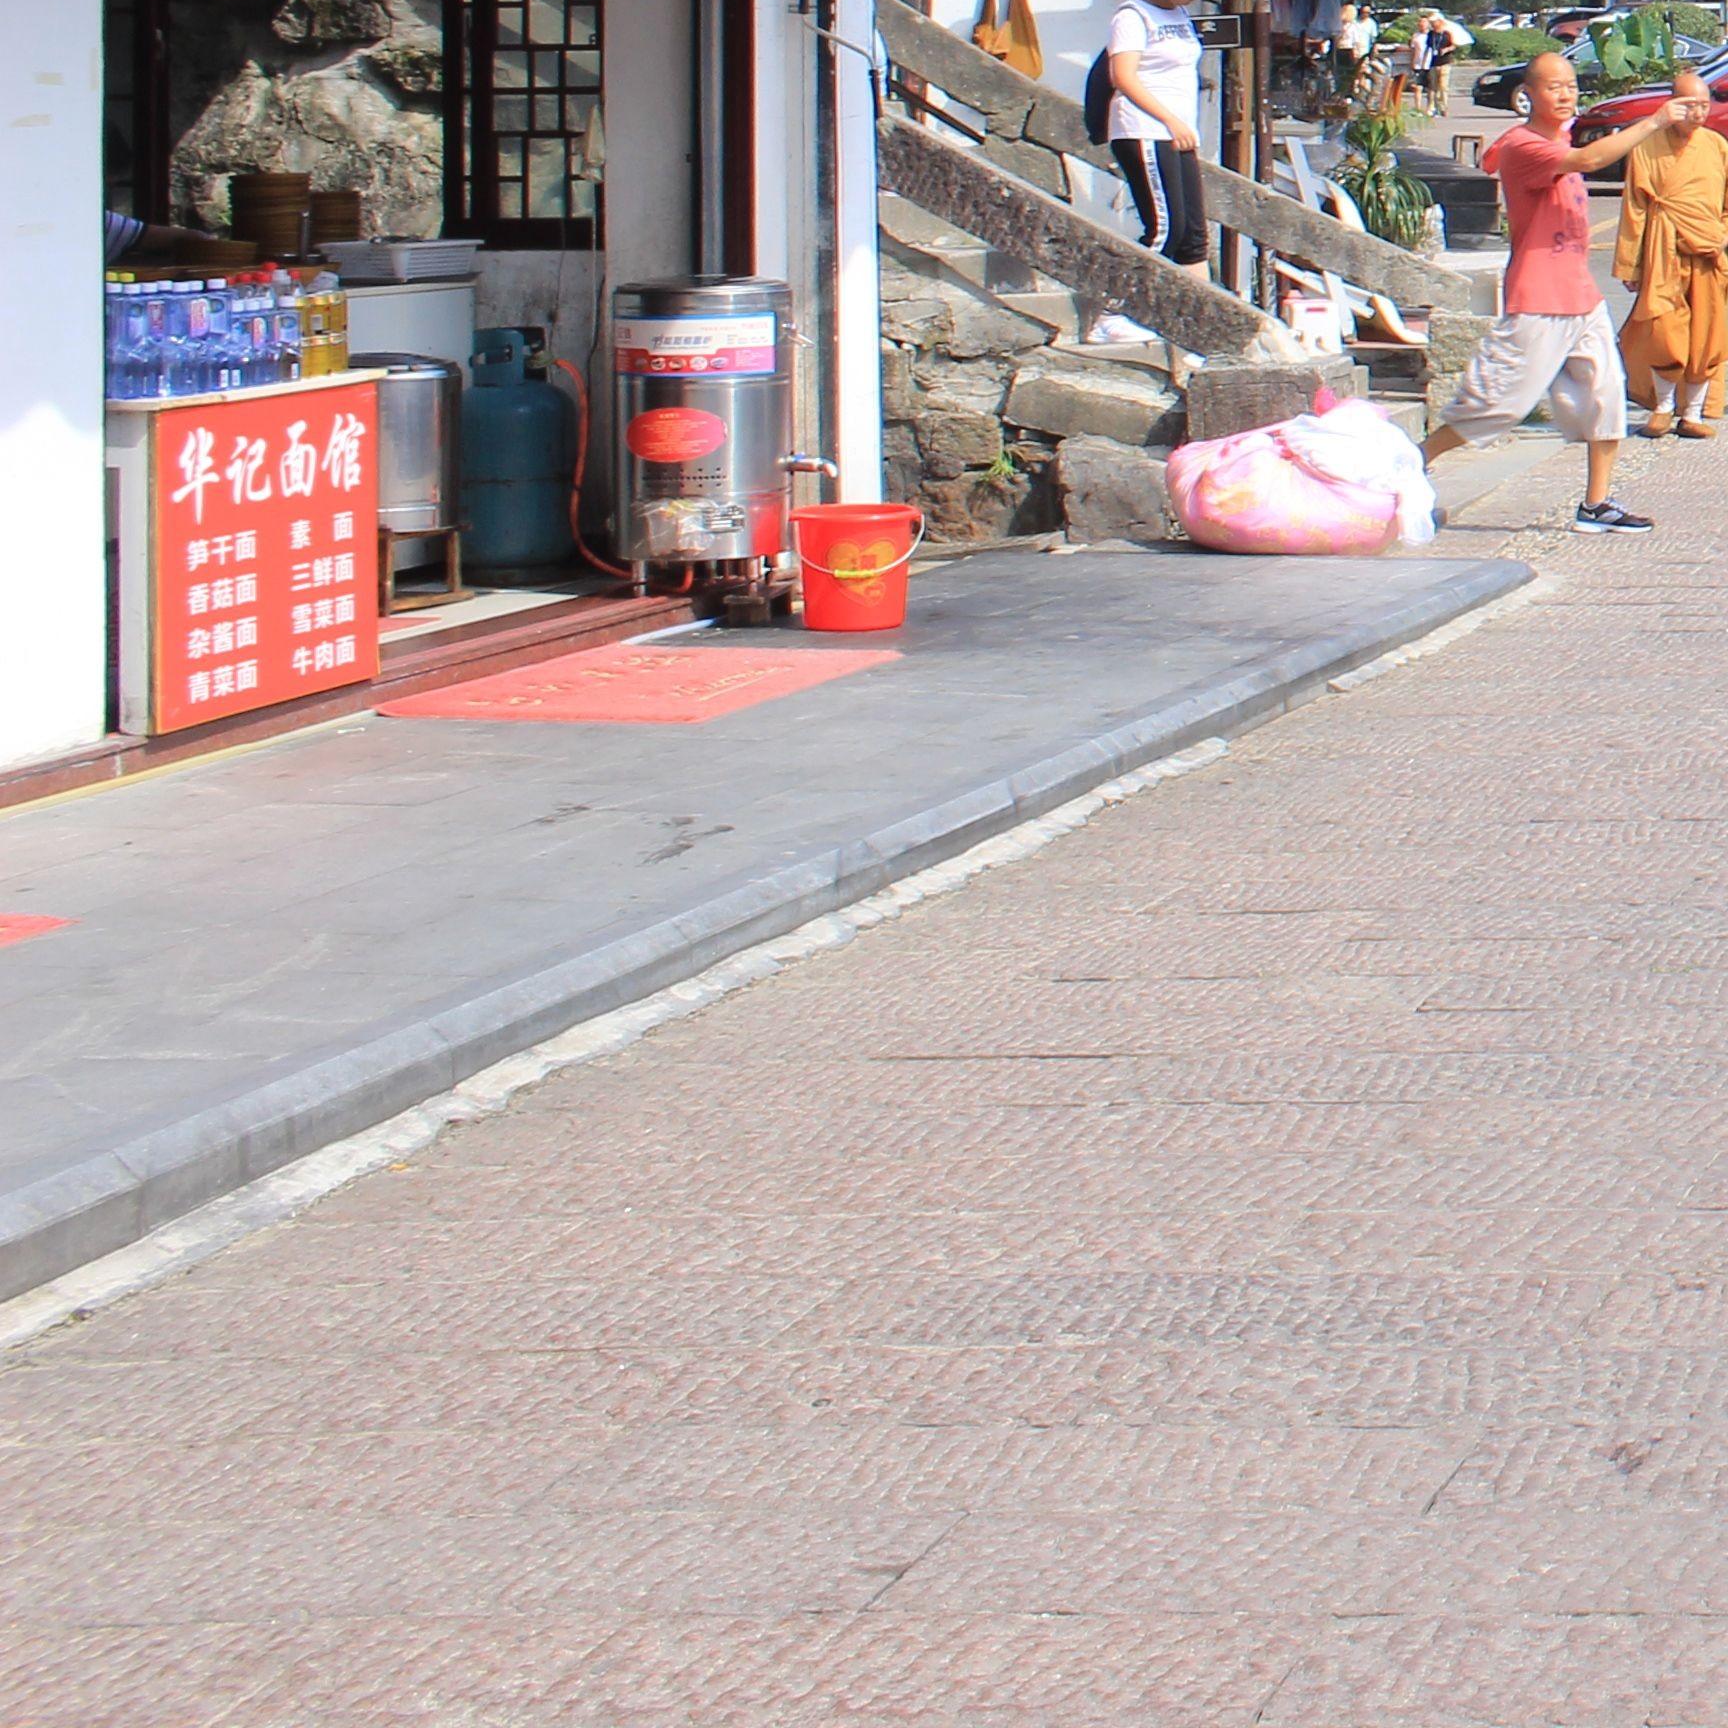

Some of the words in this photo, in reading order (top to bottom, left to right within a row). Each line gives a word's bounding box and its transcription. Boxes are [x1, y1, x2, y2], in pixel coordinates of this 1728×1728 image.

[172, 413, 366, 525] 华记面馆
[186, 530, 257, 571] 笋干面
[290, 553, 354, 591] 三鲜面
[187, 573, 258, 616] 香菇面
[291, 594, 355, 634] 雪菜面
[187, 616, 258, 659] 杂酱面
[291, 635, 356, 676] 牛肉面
[187, 659, 259, 704] 青菜面
